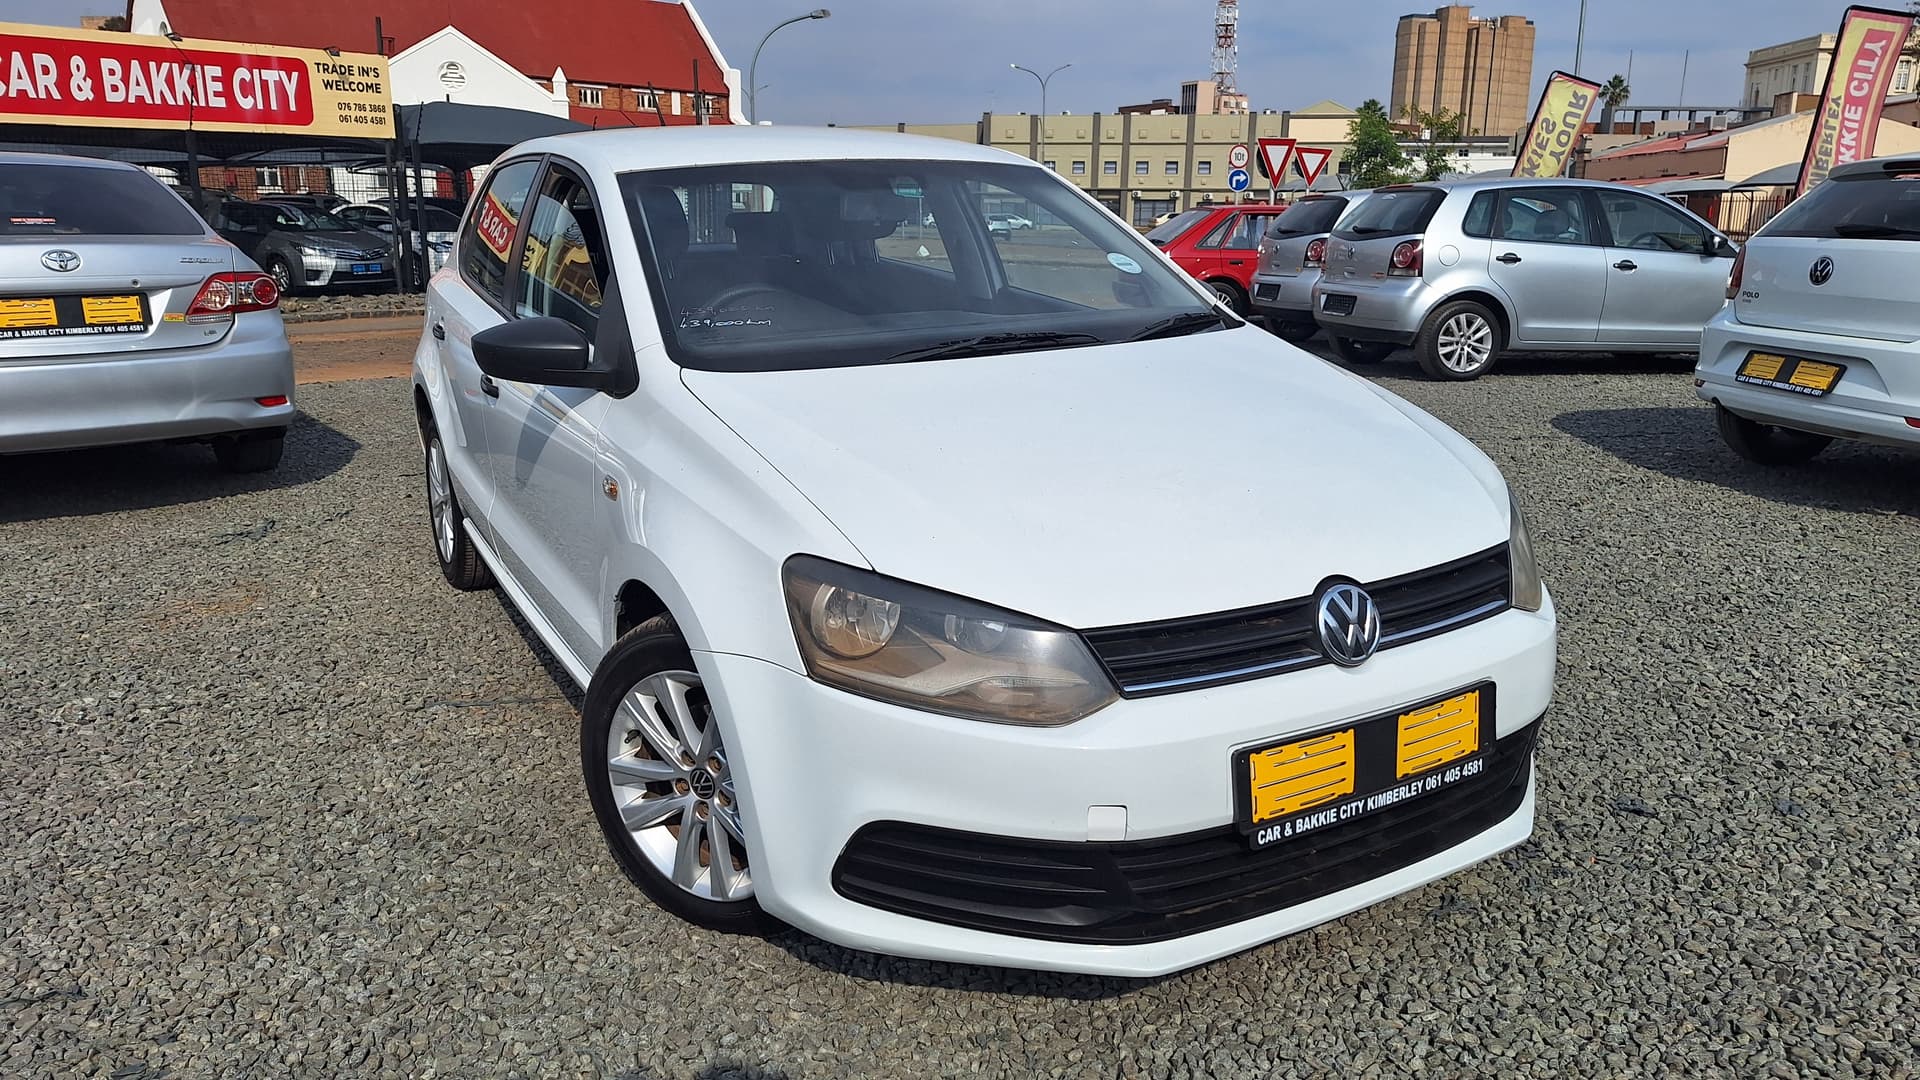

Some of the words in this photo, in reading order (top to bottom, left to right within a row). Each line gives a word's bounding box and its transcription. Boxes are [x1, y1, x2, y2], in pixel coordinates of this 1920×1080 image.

[314, 62, 354, 76] TRADE
[358, 65, 380, 78] IN'S
[70, 55, 94, 101] &
[100, 57, 226, 108] BAKKIE
[233, 67, 298, 111] CITY
[322, 79, 382, 94] WELCOME
[337, 102, 352, 111] 076
[353, 103, 367, 112] 786
[368, 104, 386, 113] 3868
[339, 114, 352, 123] 061
[354, 115, 368, 124] 405
[370, 116, 386, 125] 4581
[1742, 290, 1760, 299] POLO
[48, 328, 64, 336] CITY
[65, 326, 102, 335] KIMBERLEY
[1257, 825, 1281, 845] CAR
[1284, 821, 1293, 837] &
[1295, 808, 1338, 834] BAKKIE
[1340, 800, 1365, 820] CITY
[1367, 779, 1424, 811] KIMBERLEY
[1425, 773, 1441, 791] 061
[1444, 766, 1461, 784] 405
[1462, 758, 1483, 776] 4581
